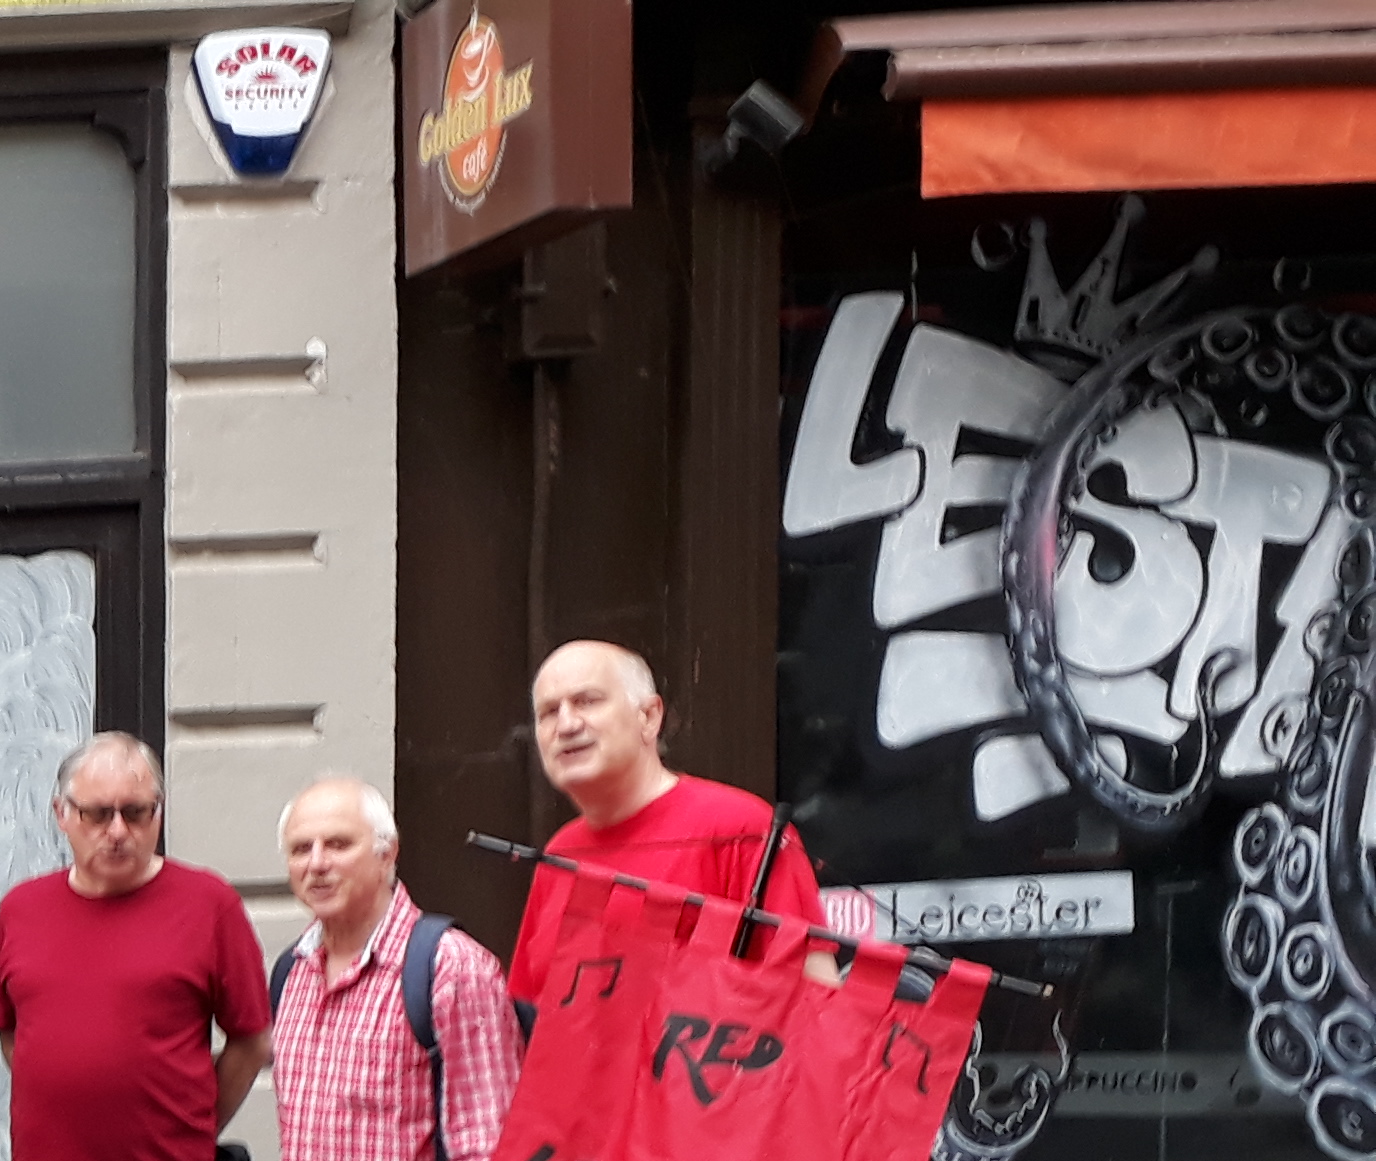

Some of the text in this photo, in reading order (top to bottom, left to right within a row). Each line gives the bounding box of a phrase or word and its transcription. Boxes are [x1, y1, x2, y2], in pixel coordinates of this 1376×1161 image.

[215, 39, 317, 78] SOLAR
[224, 84, 307, 101] SECURITY
[419, 62, 533, 164] Golden Lux
[891, 882, 1103, 940] Leicester
[651, 1013, 784, 1107] RED
